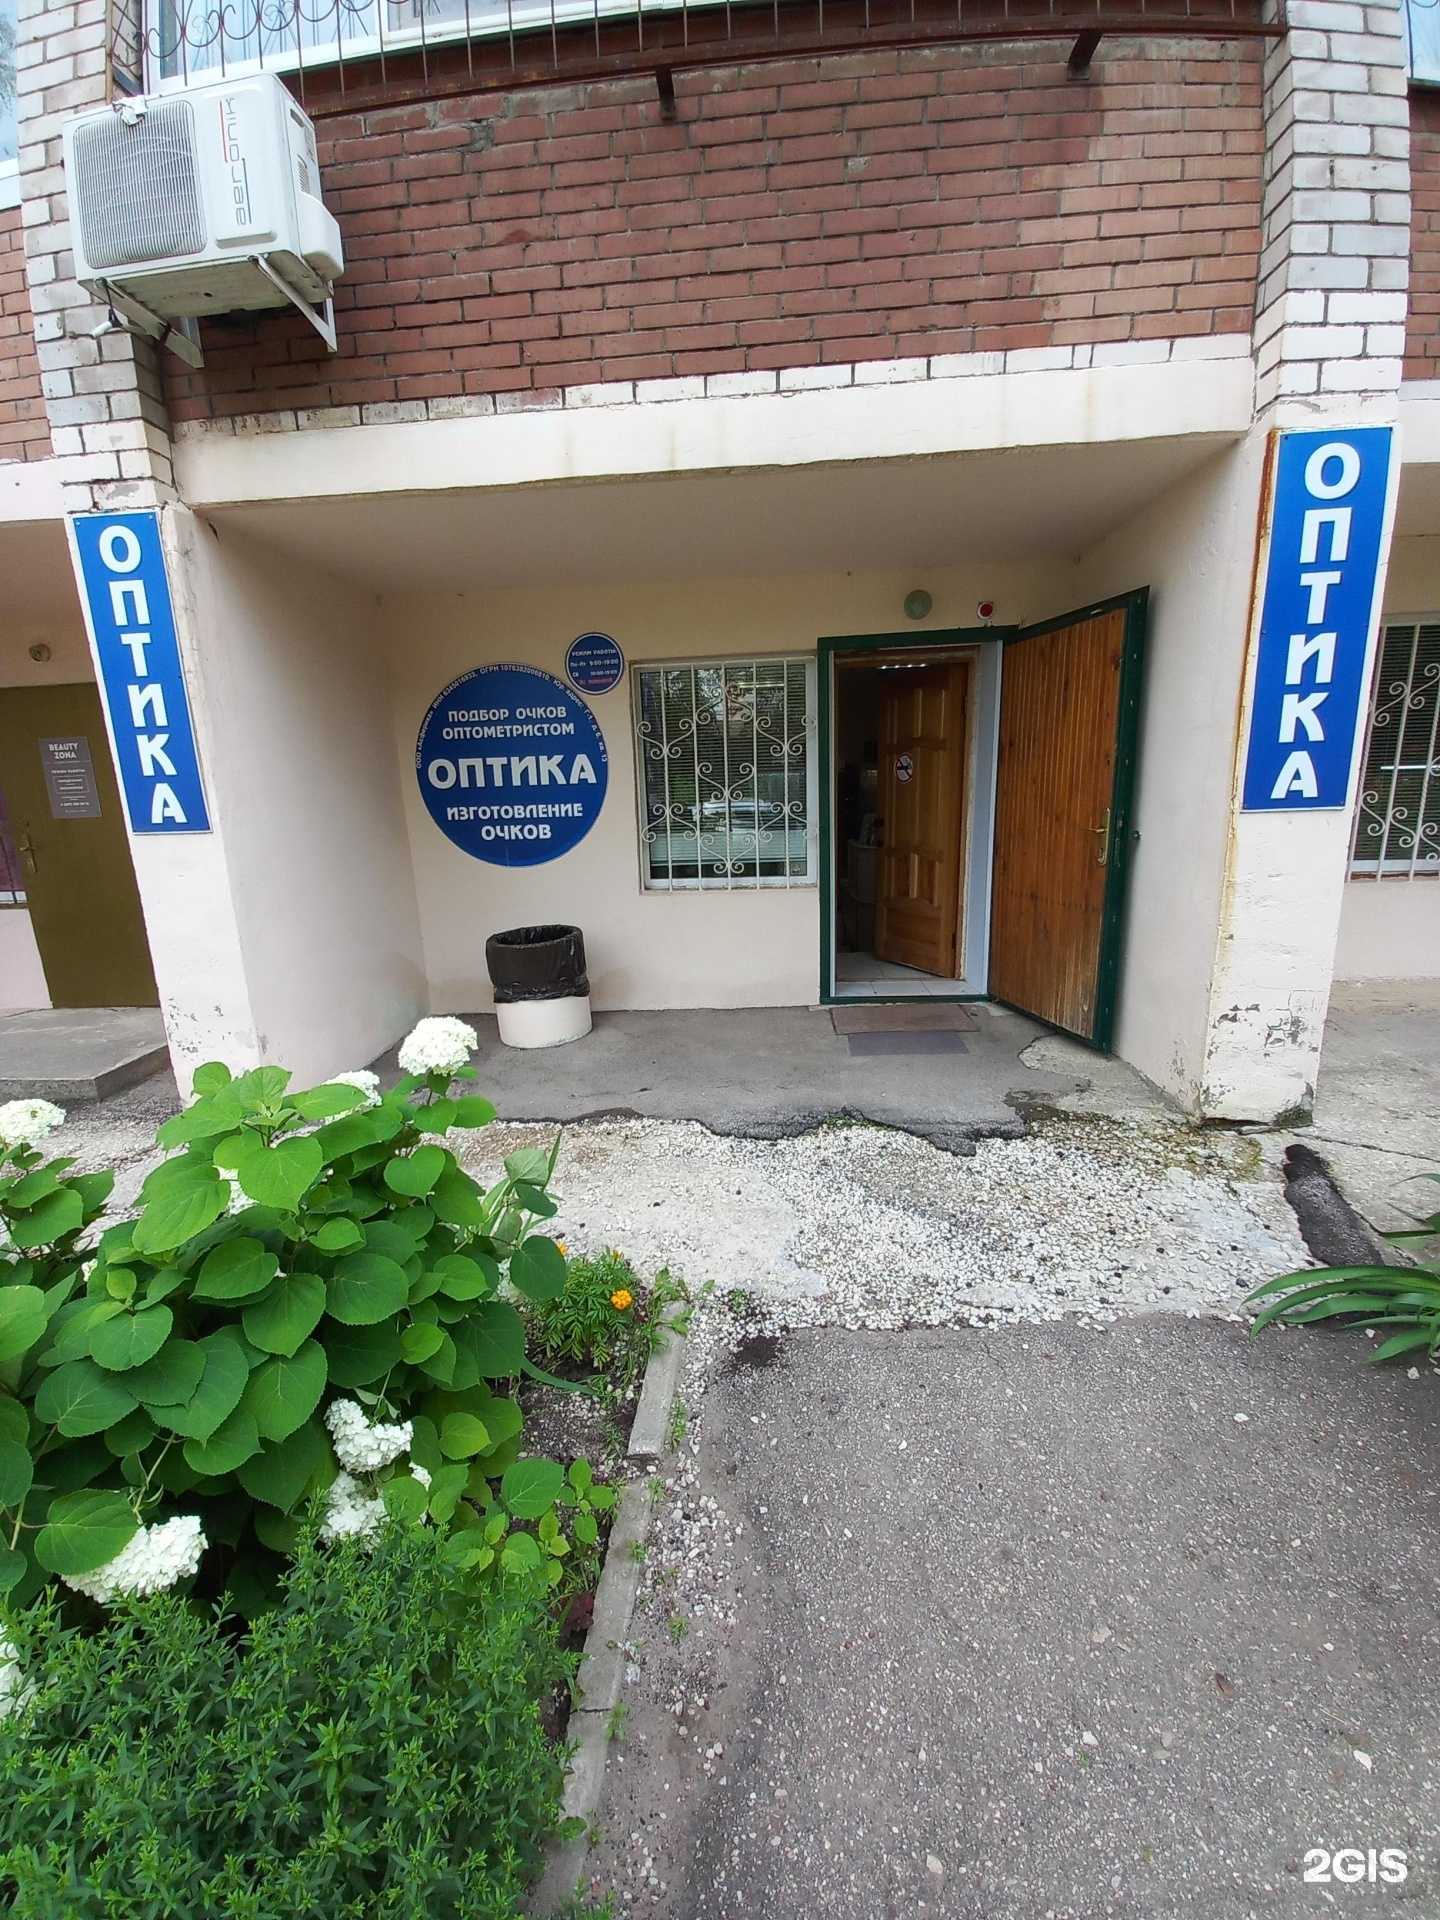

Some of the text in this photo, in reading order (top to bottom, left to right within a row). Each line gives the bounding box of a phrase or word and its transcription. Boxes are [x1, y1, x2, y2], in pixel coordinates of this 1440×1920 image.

[225, 97, 247, 225] aeronik
[1270, 441, 1360, 799] ОПТИКА
[99, 525, 188, 824] ОПТИКА
[448, 706, 567, 723] ПОДБОР ОЧКОВ
[442, 723, 575, 740] ОПТОМЕТРИСТОМ
[428, 753, 598, 789] ОПТИКА
[447, 803, 584, 821] ИЗГОТОВЛЕНИЕ
[481, 824, 552, 841] ОЧКОВ
